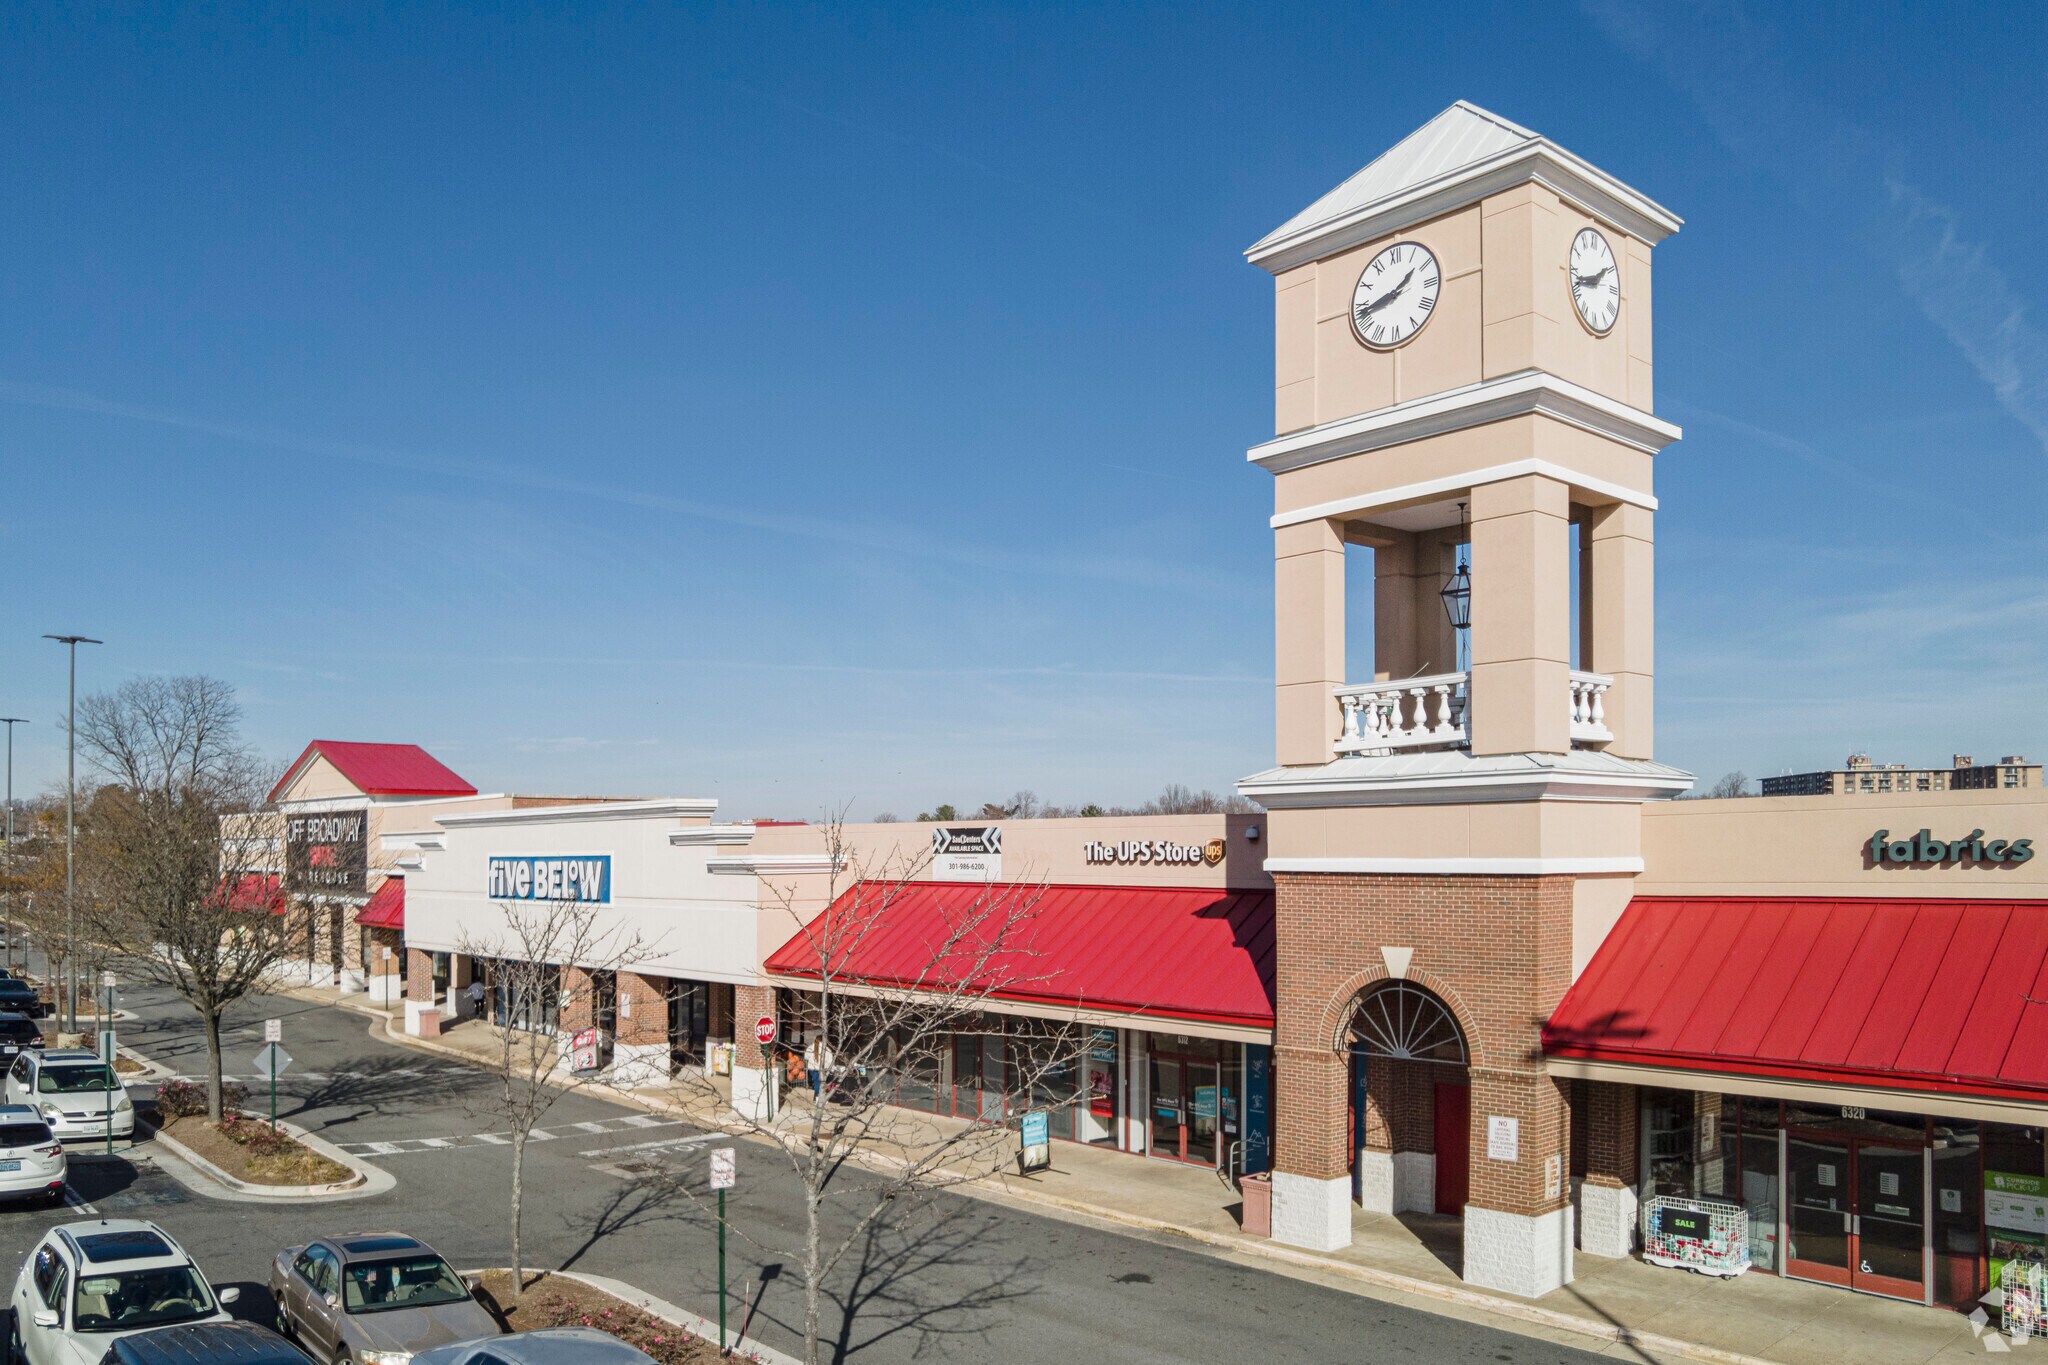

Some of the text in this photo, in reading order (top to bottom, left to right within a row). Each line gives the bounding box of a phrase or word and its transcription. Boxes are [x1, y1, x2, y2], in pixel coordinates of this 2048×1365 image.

[287, 816, 361, 843] OFF BROADWAY
[1085, 841, 1201, 861] The UPS Store
[1871, 828, 2034, 862] fabrics
[1206, 845, 1221, 860] ups
[489, 860, 530, 898] five
[756, 1023, 774, 1036] STOP
[1178, 1035, 1189, 1045] 6312
[1841, 1106, 1866, 1120] 6320
[636, 1142, 709, 1156] STOP
[1675, 1218, 1695, 1229] SALE
